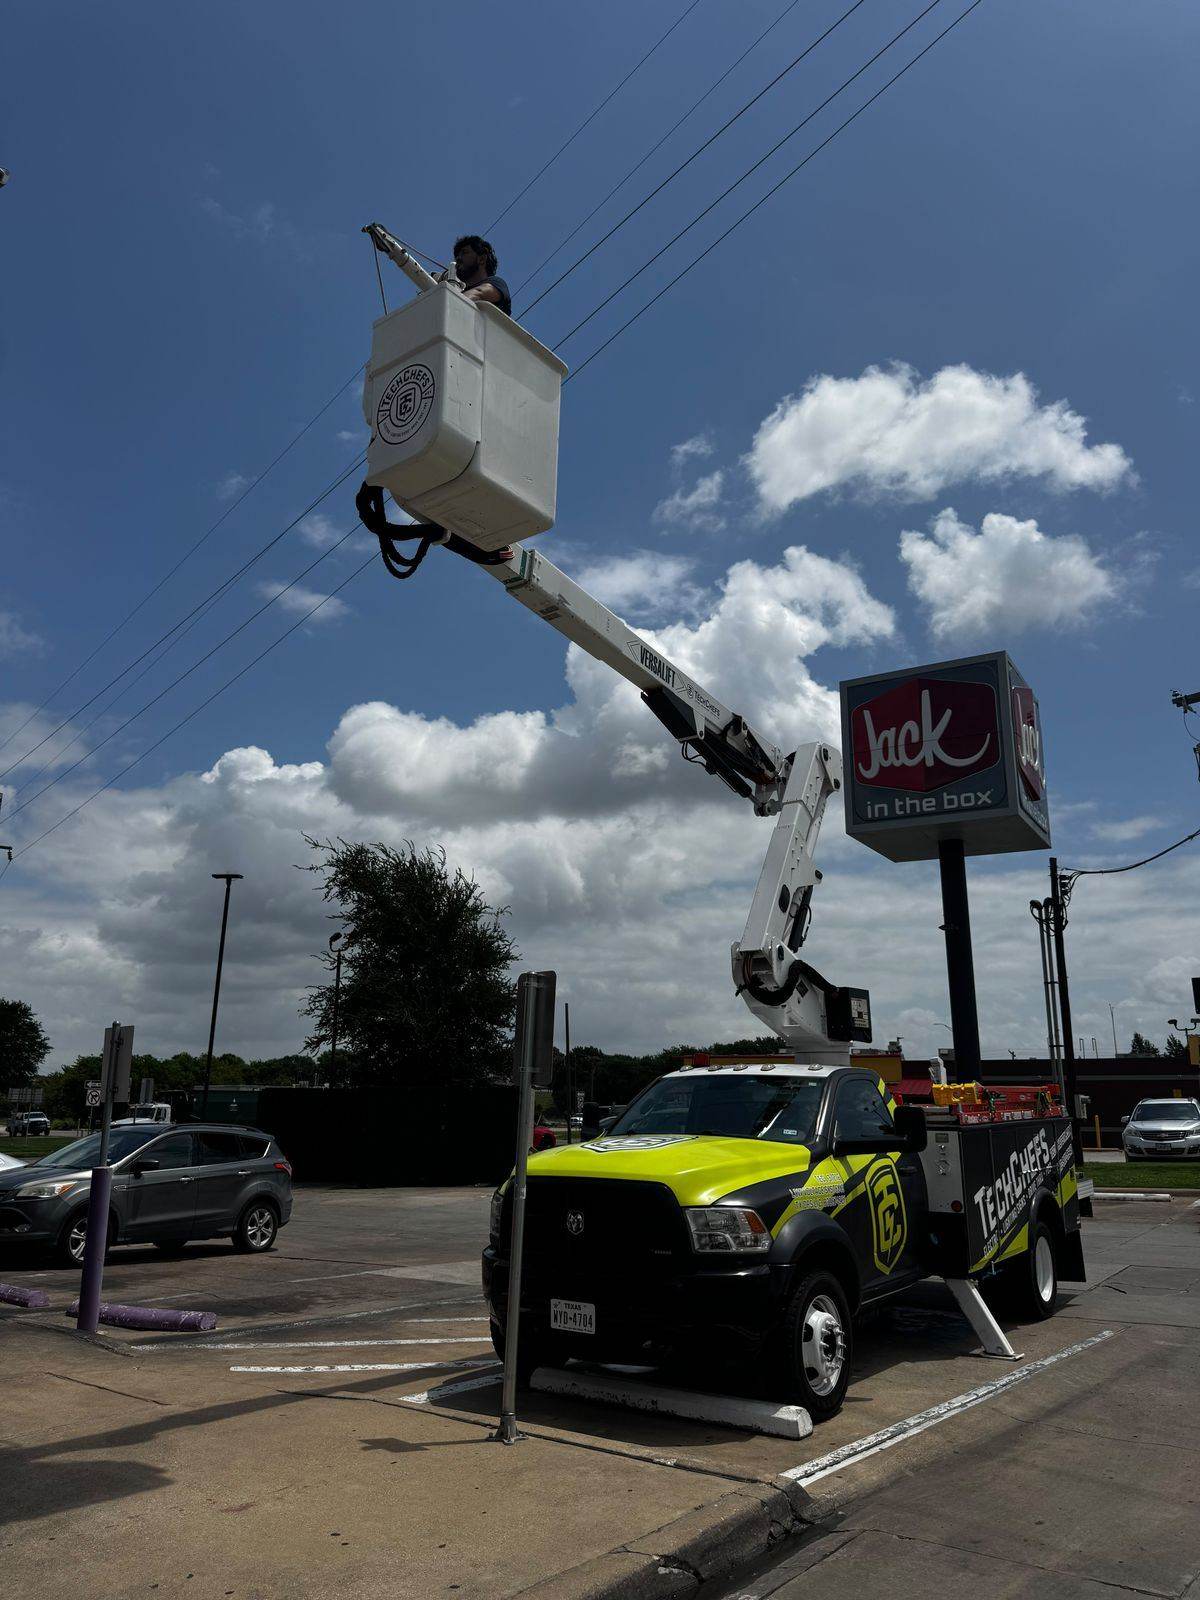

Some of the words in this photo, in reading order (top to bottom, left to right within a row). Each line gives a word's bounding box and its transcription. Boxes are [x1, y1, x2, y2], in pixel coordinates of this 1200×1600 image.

[640, 645, 676, 688] VERSALIFT
[858, 689, 991, 780] Jack
[867, 801, 889, 819] in
[895, 797, 937, 815] the
[943, 791, 992, 810] box
[564, 1302, 581, 1310] TEXAS
